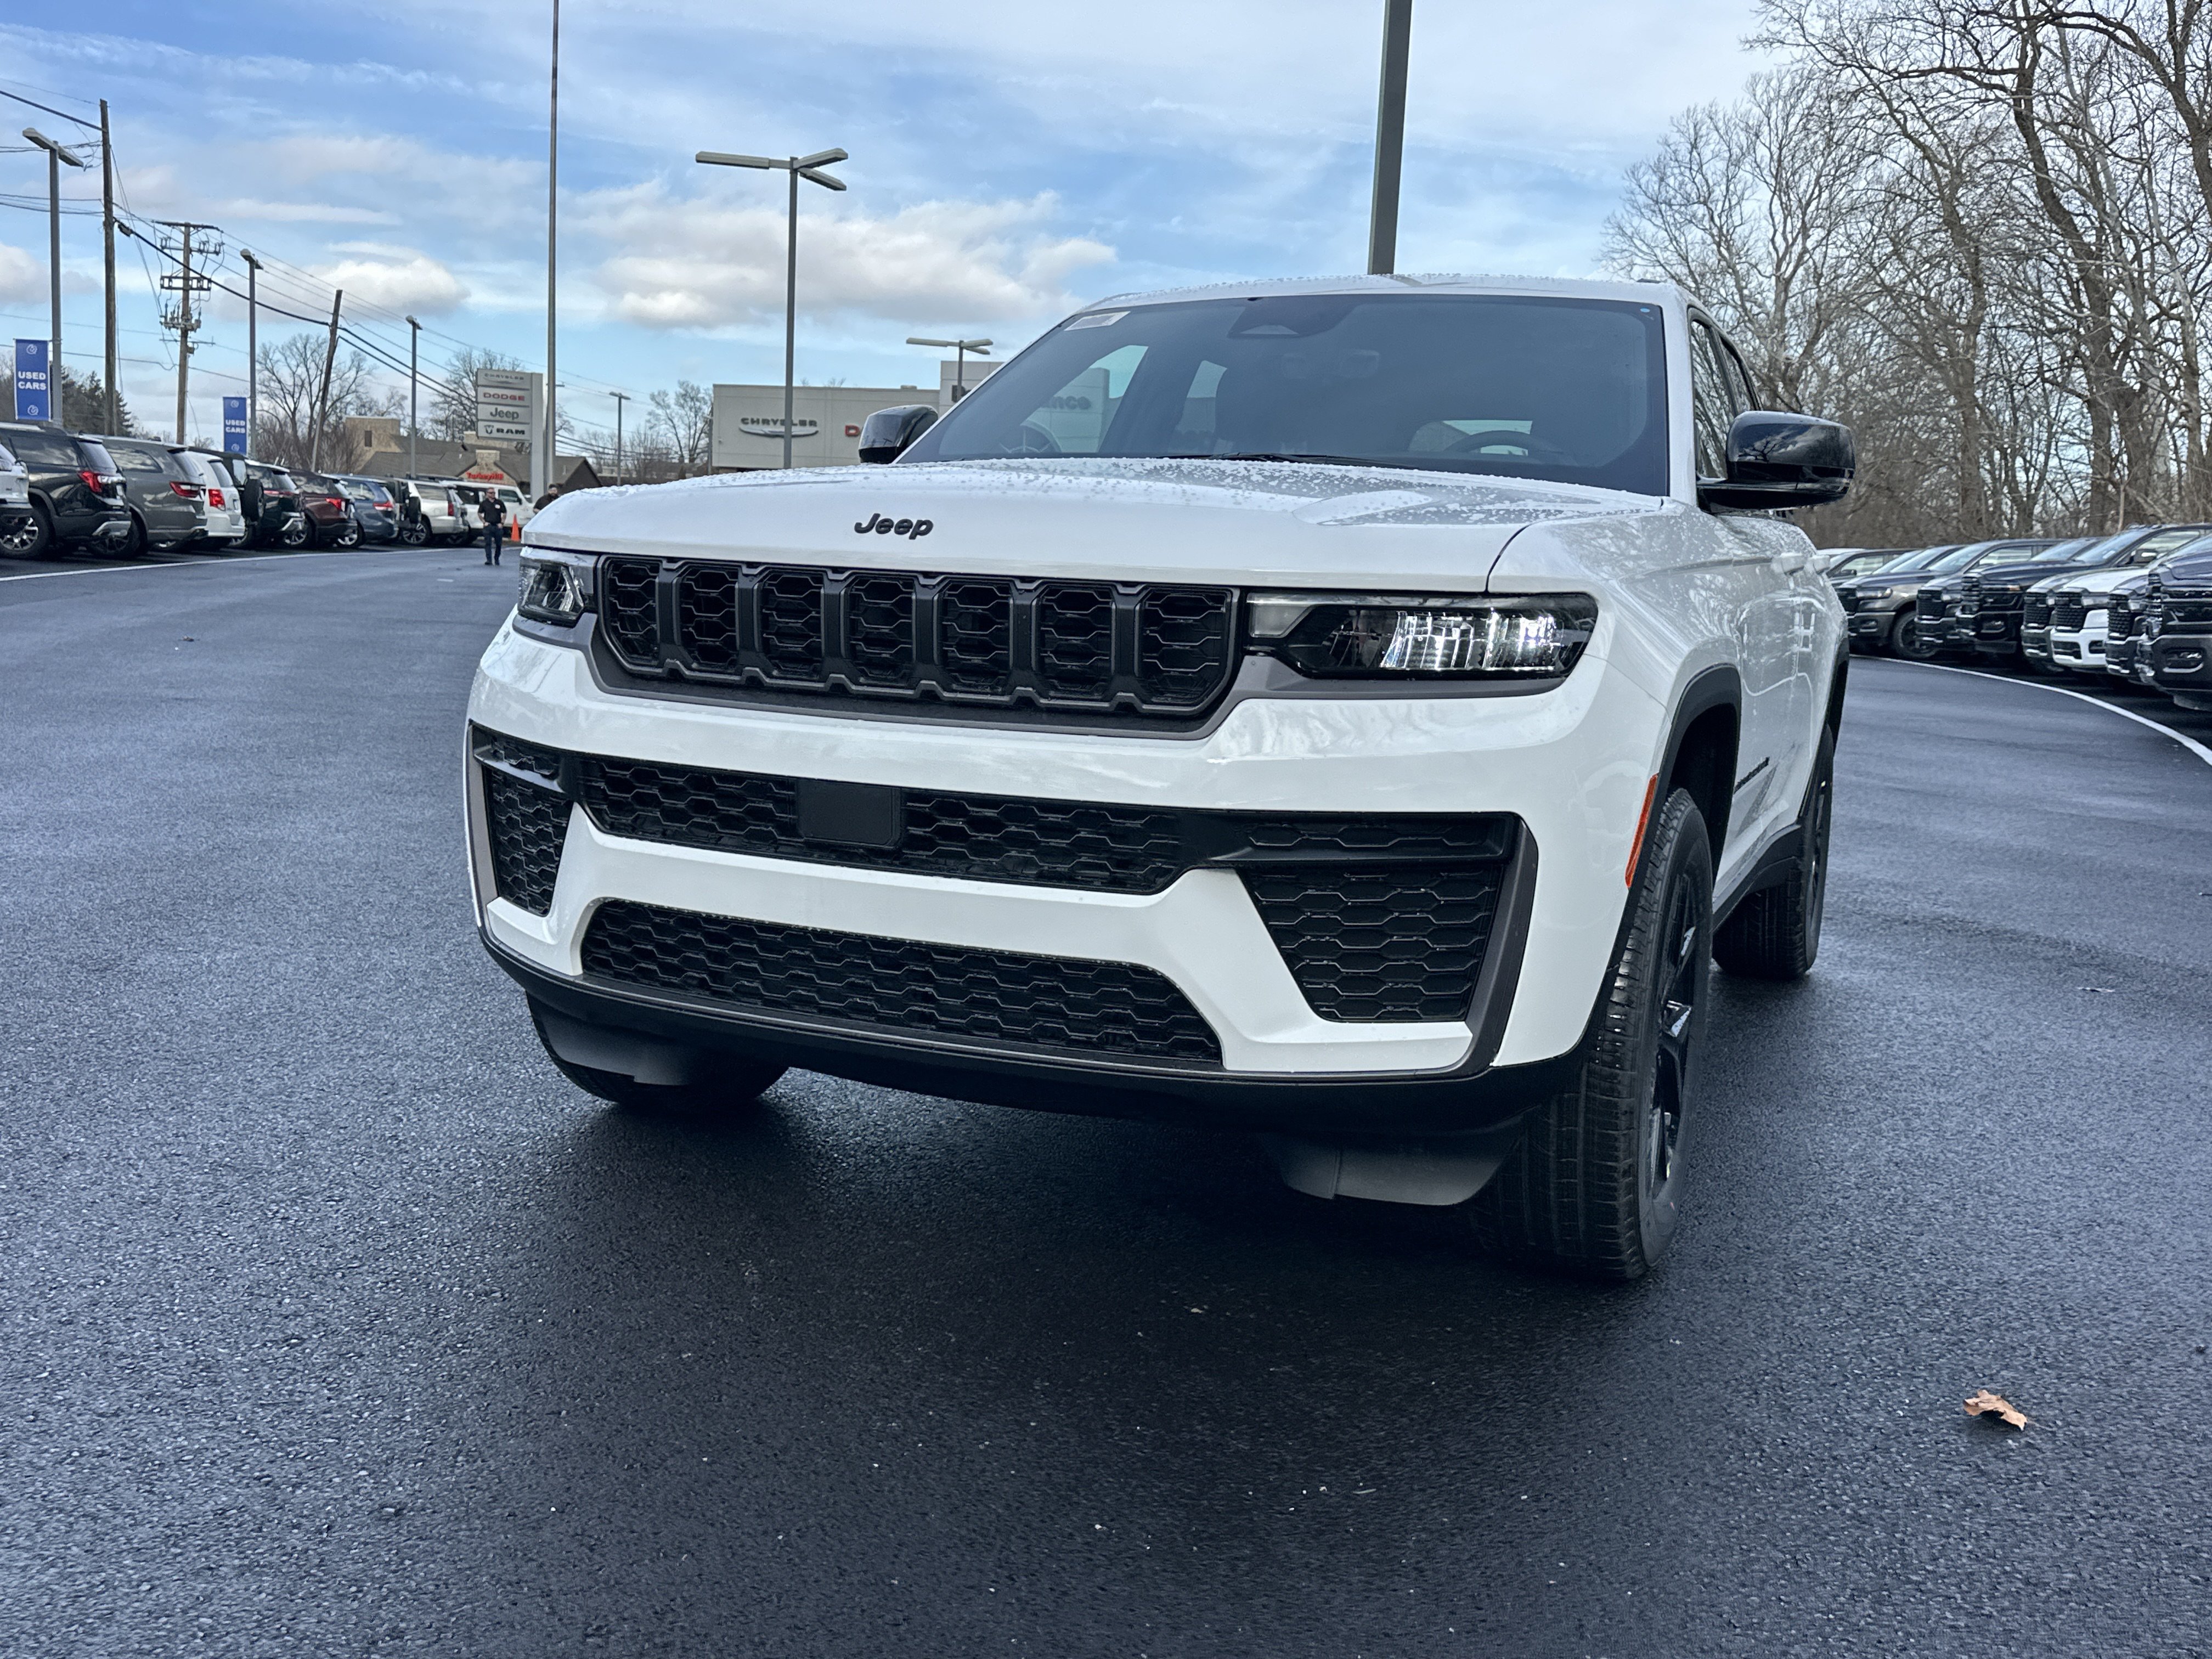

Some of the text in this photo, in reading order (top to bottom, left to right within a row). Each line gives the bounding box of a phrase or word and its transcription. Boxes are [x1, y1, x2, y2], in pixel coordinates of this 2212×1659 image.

[18, 371, 46, 380] USED
[18, 381, 46, 390] CARS
[483, 392, 525, 402] DODGE
[490, 407, 519, 420] Jeep
[854, 513, 933, 540] Jeep
